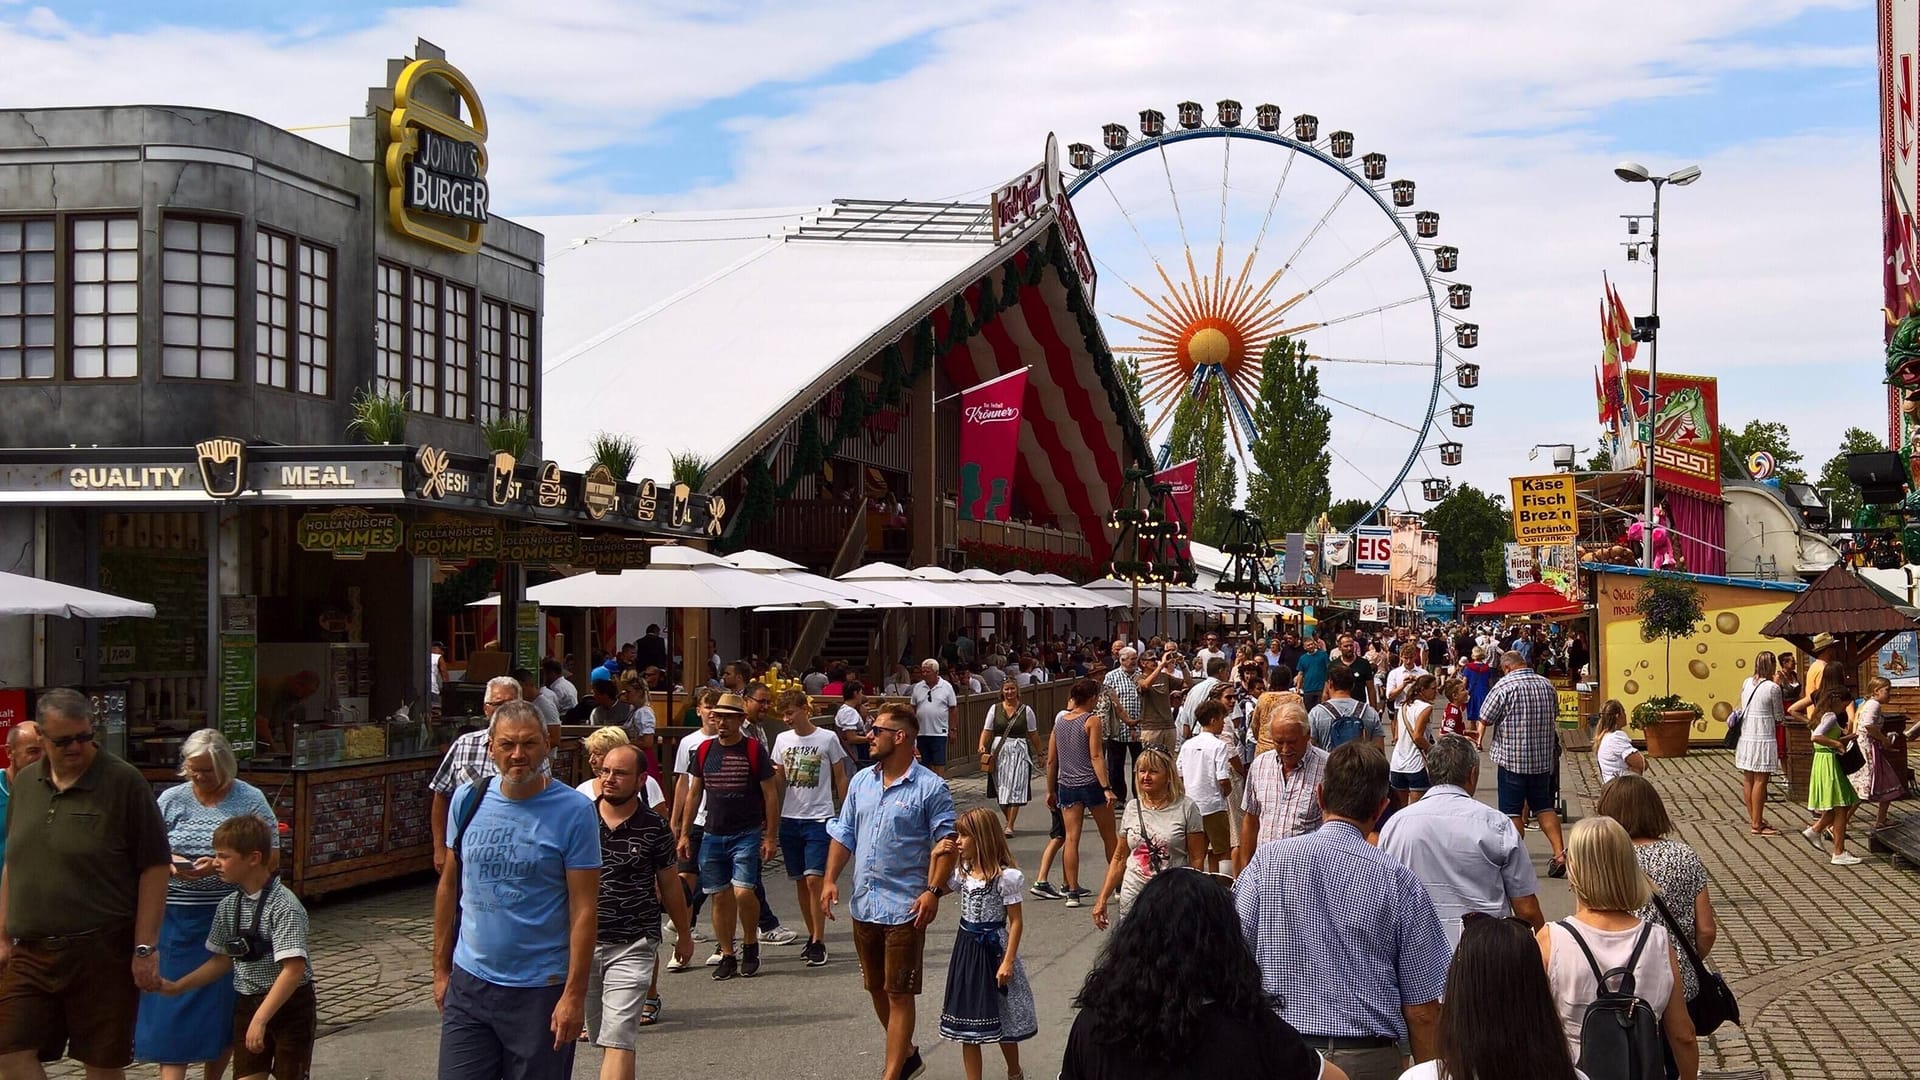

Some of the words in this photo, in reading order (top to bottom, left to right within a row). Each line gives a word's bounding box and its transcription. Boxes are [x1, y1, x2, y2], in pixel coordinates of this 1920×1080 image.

[413, 166, 487, 220] BURGER
[69, 467, 184, 488] QUALITY
[281, 465, 355, 487] MEAL
[1522, 479, 1564, 491] Käse
[1522, 493, 1566, 506] Fisch
[307, 529, 394, 547] POMMES
[1522, 524, 1572, 534] Getränke
[415, 538, 495, 554] POMMES
[1358, 538, 1391, 561] EIS
[467, 827, 516, 847] OUGH
[468, 844, 519, 864] WORK
[479, 861, 537, 880] ROUGH
